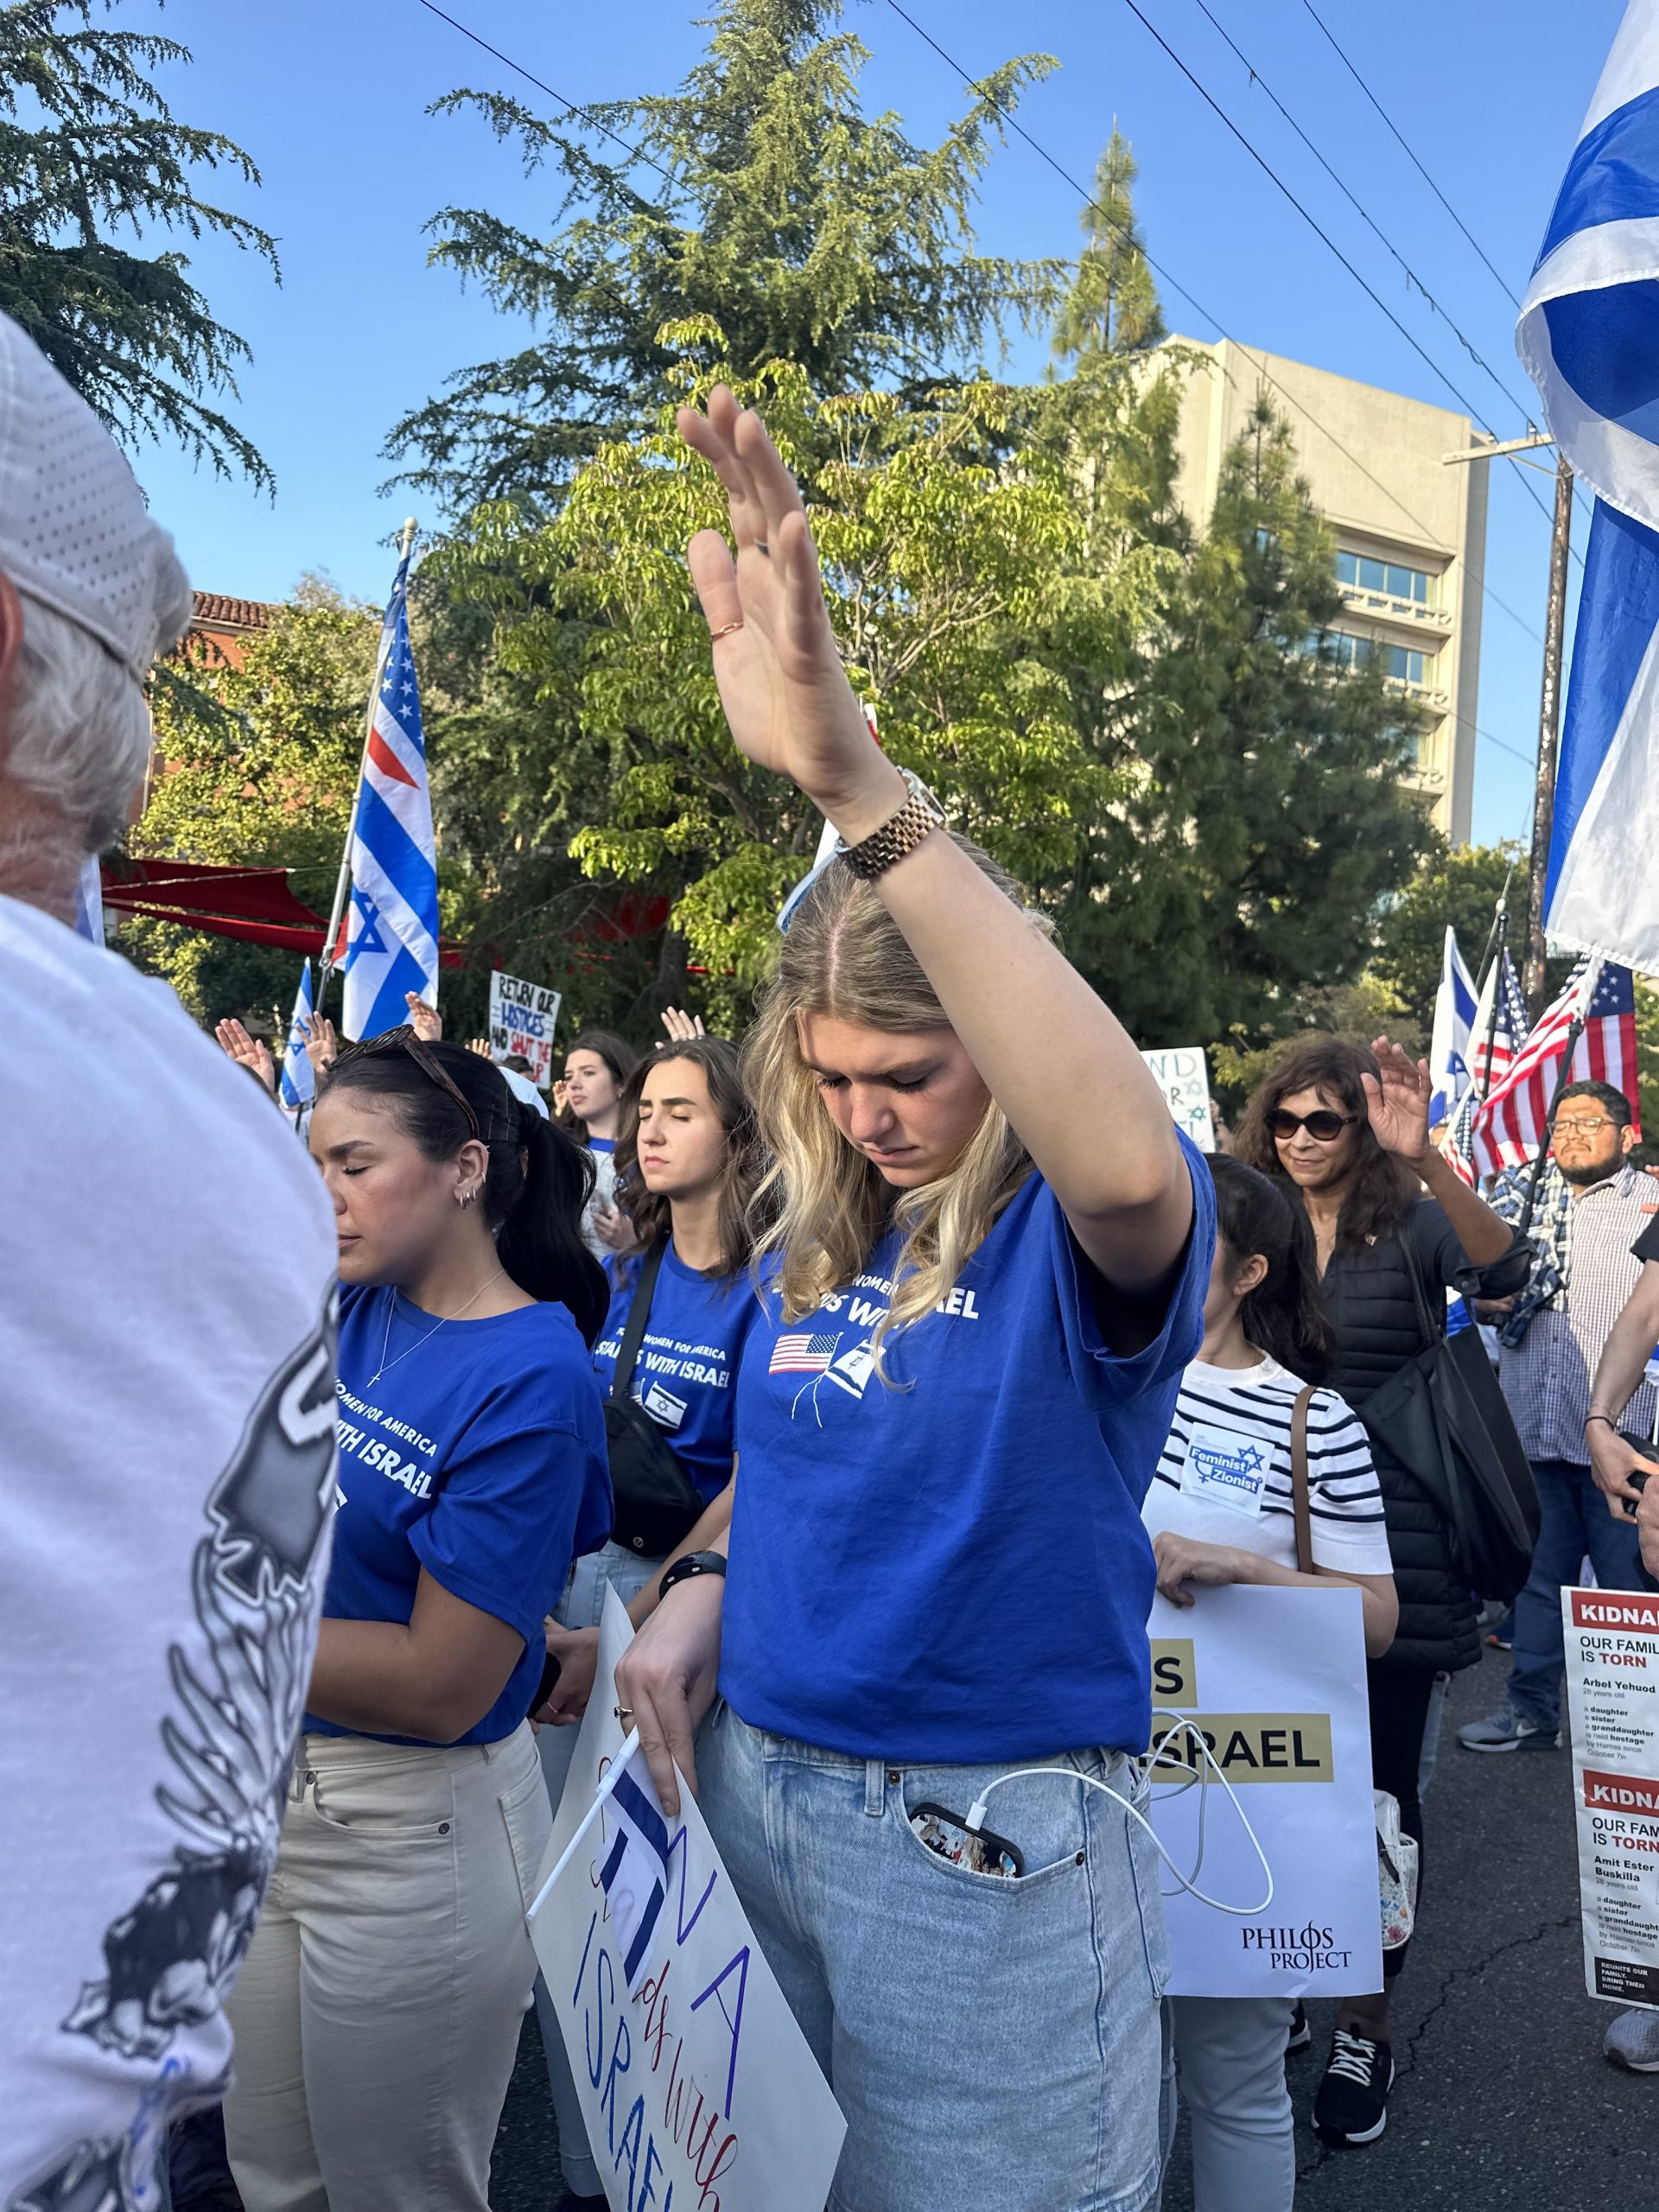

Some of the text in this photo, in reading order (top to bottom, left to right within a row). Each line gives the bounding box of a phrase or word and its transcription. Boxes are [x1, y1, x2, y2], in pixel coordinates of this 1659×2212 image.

[674, 1341, 692, 1354] FOR
[645, 1351, 682, 1375] WITH
[678, 1360, 730, 1388] ISRAEL
[362, 1406, 383, 1422] FOR
[379, 1416, 437, 1458] AMERICA
[336, 1419, 432, 1499] ITH ISRAEL
[1191, 1447, 1247, 1471] Feminist
[1211, 1469, 1257, 1492] Zionist
[1580, 1604, 1659, 1627] KIDNA
[1580, 1636, 1659, 1655] OUR FAMIL
[1581, 1650, 1646, 1668] IS TORN
[1583, 1677, 1611, 1688] Arbel
[1590, 1706, 1628, 1716] daughter
[1591, 1715, 1615, 1724] sister
[1592, 1724, 1654, 1737] granddaughter
[1610, 1734, 1644, 1745] hostage
[1138, 1730, 1320, 1769] SRAEL
[1592, 1817, 1659, 1837] OUR FAM
[1593, 1833, 1659, 1853] IS TORN
[1594, 1855, 1654, 1872] Amit Ester
[1595, 1867, 1640, 1882] Buskilla
[1604, 1897, 1642, 1910] daughter
[1604, 1906, 1628, 1916] sister
[1605, 1916, 1659, 1931] granddaught
[1623, 1928, 1658, 1940] hostage
[1270, 1951, 1351, 1974] PROJECT
[1632, 1967, 1648, 1976] OUR
[1602, 1976, 1645, 1989] BRING THEM
